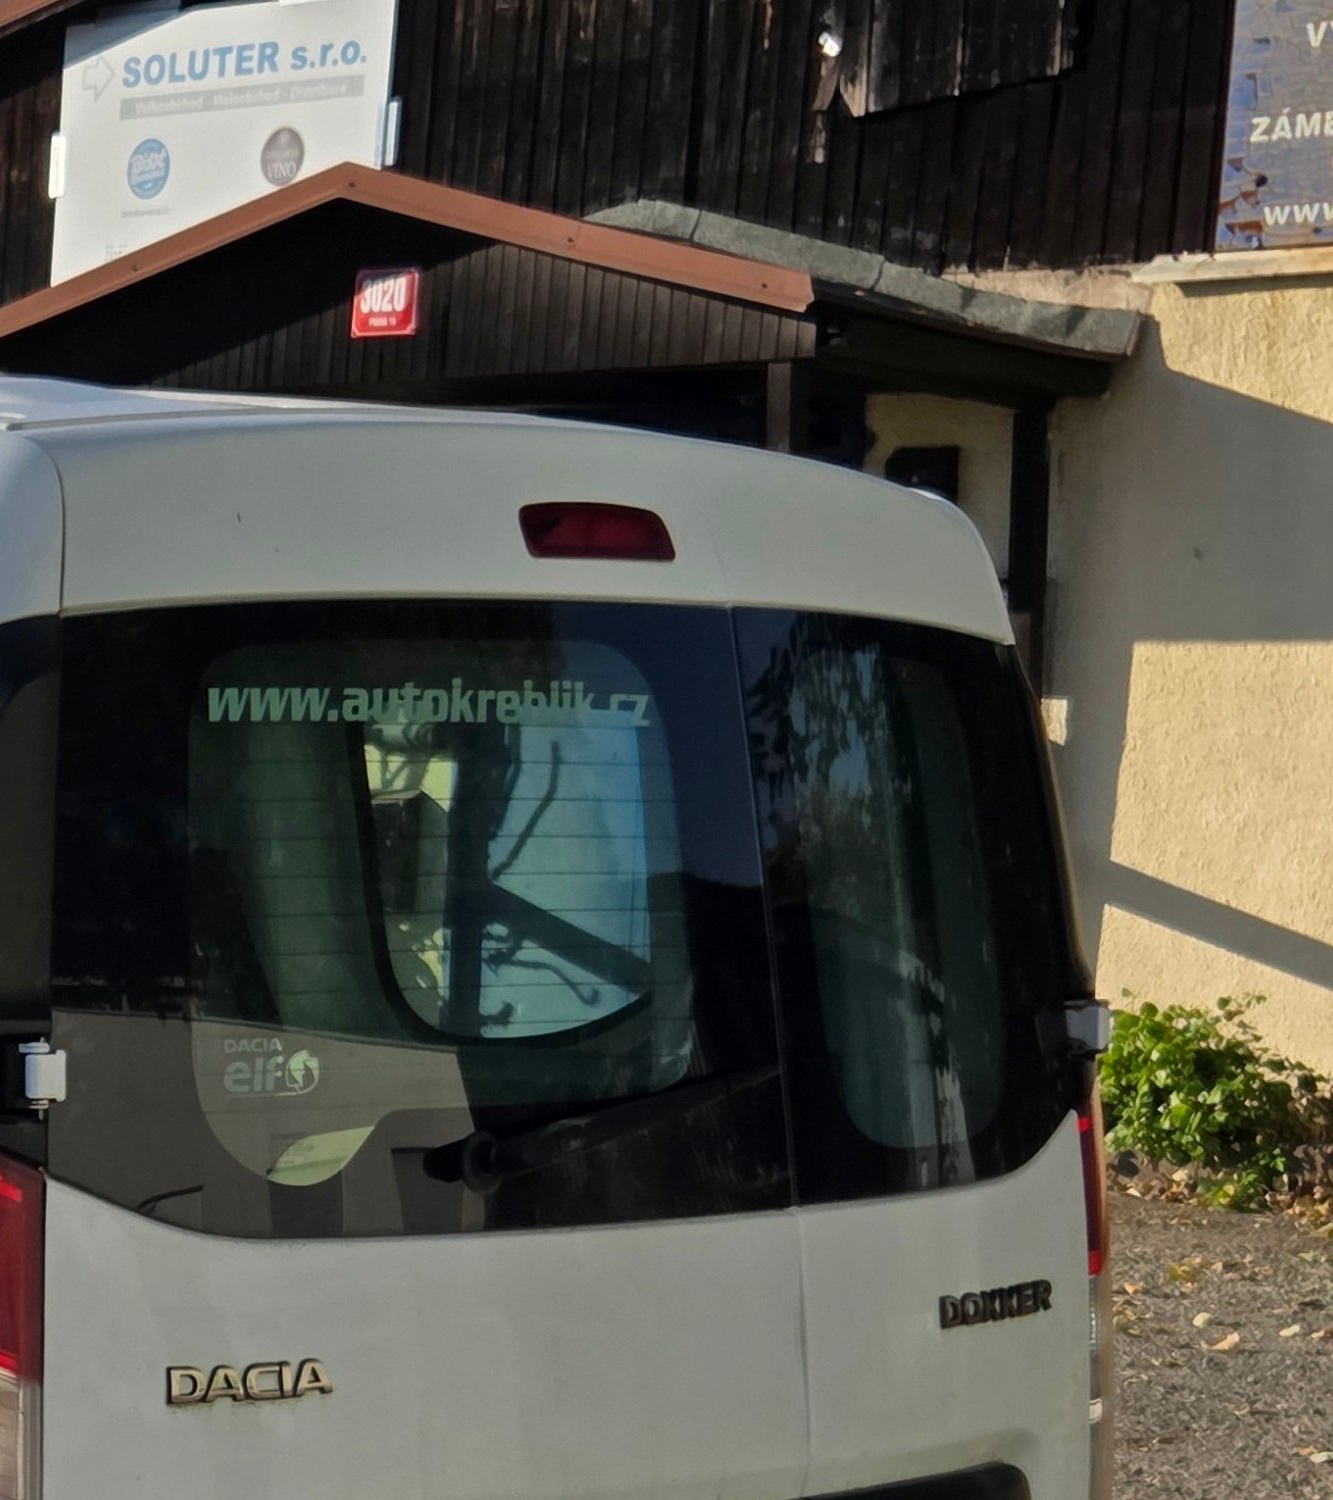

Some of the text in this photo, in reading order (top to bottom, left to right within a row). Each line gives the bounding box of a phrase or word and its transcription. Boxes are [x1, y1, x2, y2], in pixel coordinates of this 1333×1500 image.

[1306, 20, 1333, 47] V
[122, 40, 367, 88] SOLUTER s.r.o.
[360, 277, 405, 314] 3020
[224, 1037, 283, 1053] DACIA
[224, 1056, 283, 1093] elf
[939, 1279, 1053, 1330] DOKKER
[166, 1358, 333, 1405] DACIA
